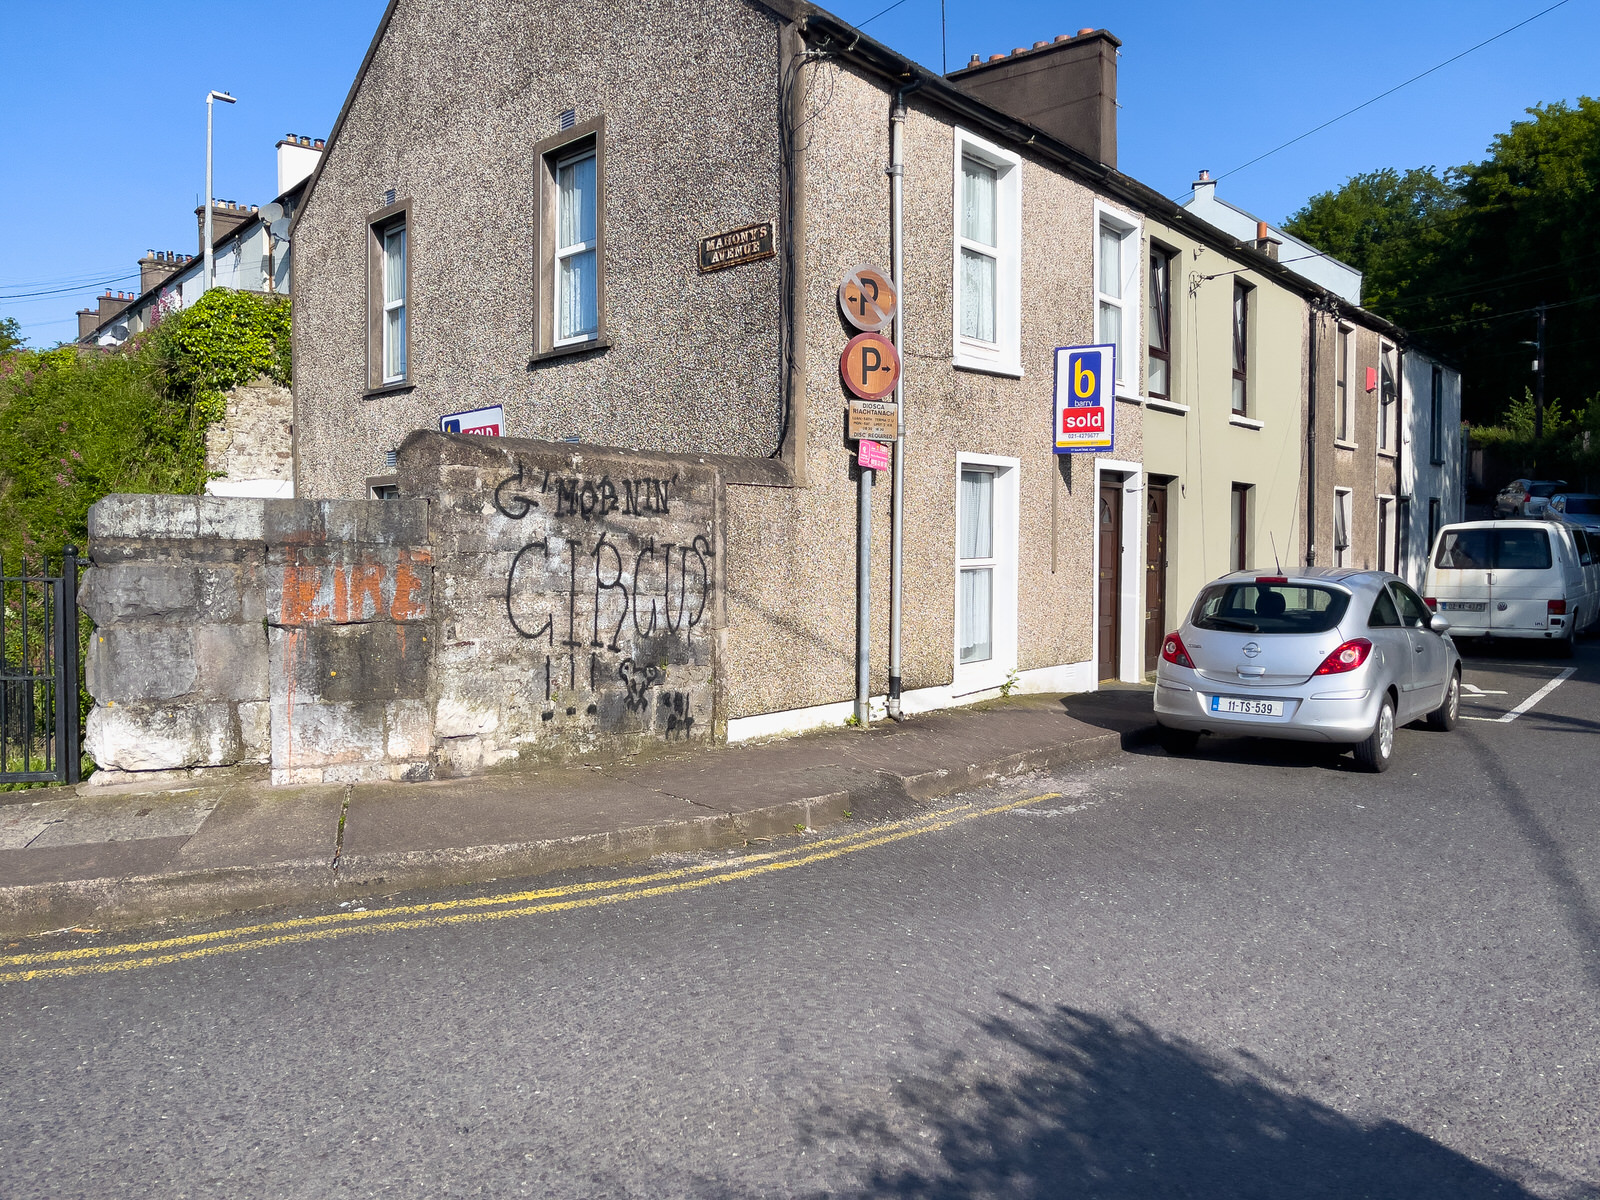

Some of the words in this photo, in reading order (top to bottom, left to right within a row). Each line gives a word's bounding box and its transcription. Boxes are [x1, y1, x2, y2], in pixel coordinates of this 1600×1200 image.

[711, 241, 760, 264] AVENUE
[862, 346, 882, 385] P
[1074, 400, 1093, 408] barry
[852, 408, 895, 416] RIACHTANACH
[1066, 412, 1101, 427] sold
[506, 532, 716, 653] CIRCUS
[1228, 700, 1273, 714] 11-TS-539
